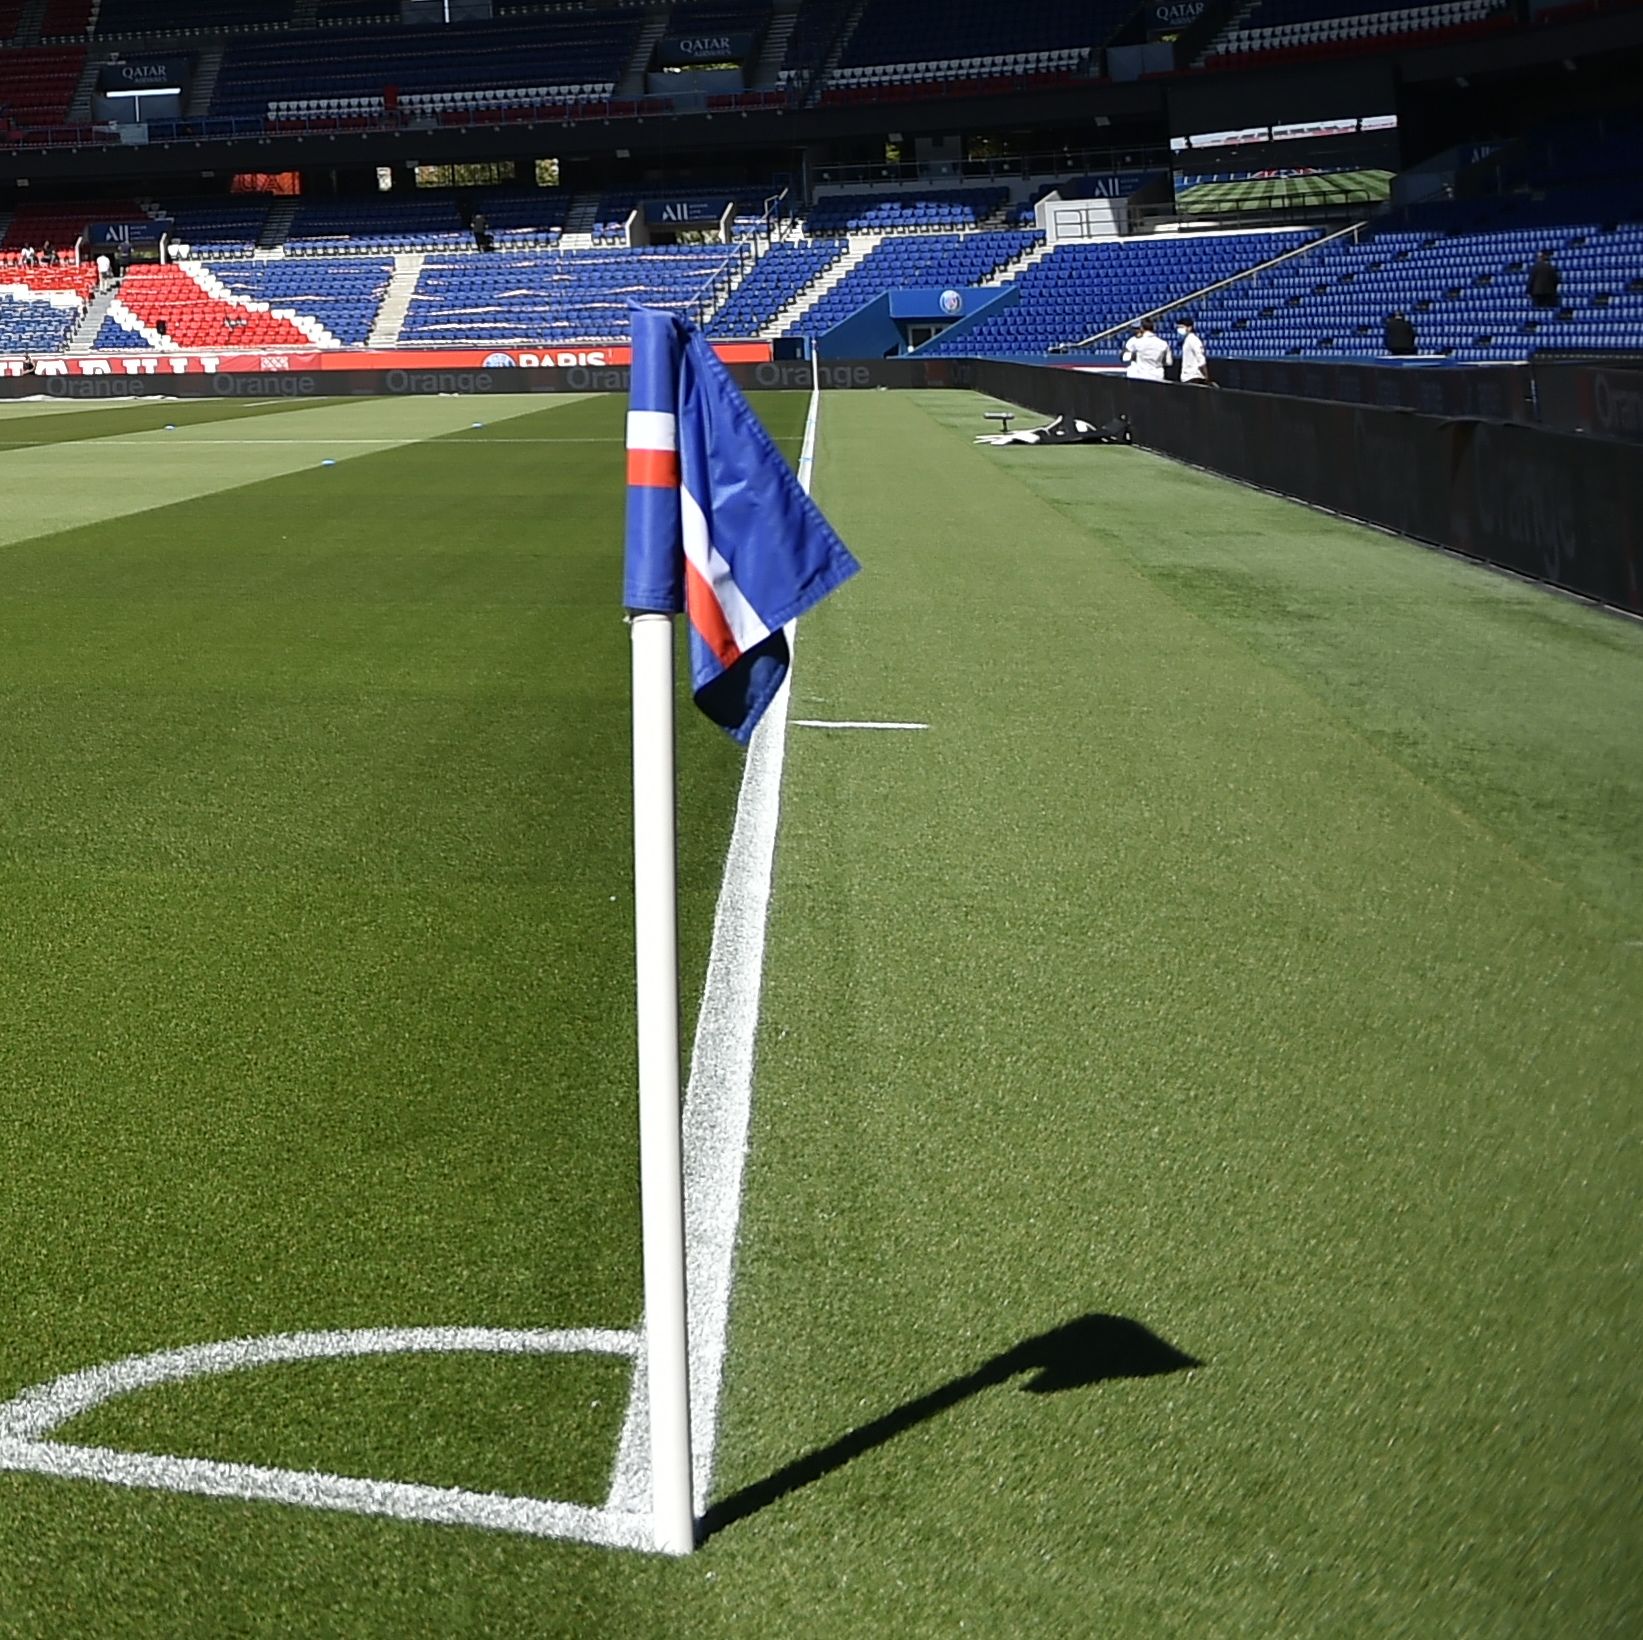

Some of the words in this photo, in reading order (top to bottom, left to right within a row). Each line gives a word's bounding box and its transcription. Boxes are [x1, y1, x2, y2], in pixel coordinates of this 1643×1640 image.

[1156, 2, 1205, 21] QATAR
[680, 37, 731, 54] QATAR
[121, 65, 167, 81] QATAR
[46, 374, 145, 398] Orange
[213, 372, 316, 397] Orange
[386, 370, 493, 394] Orange
[755, 361, 870, 388] Orange
